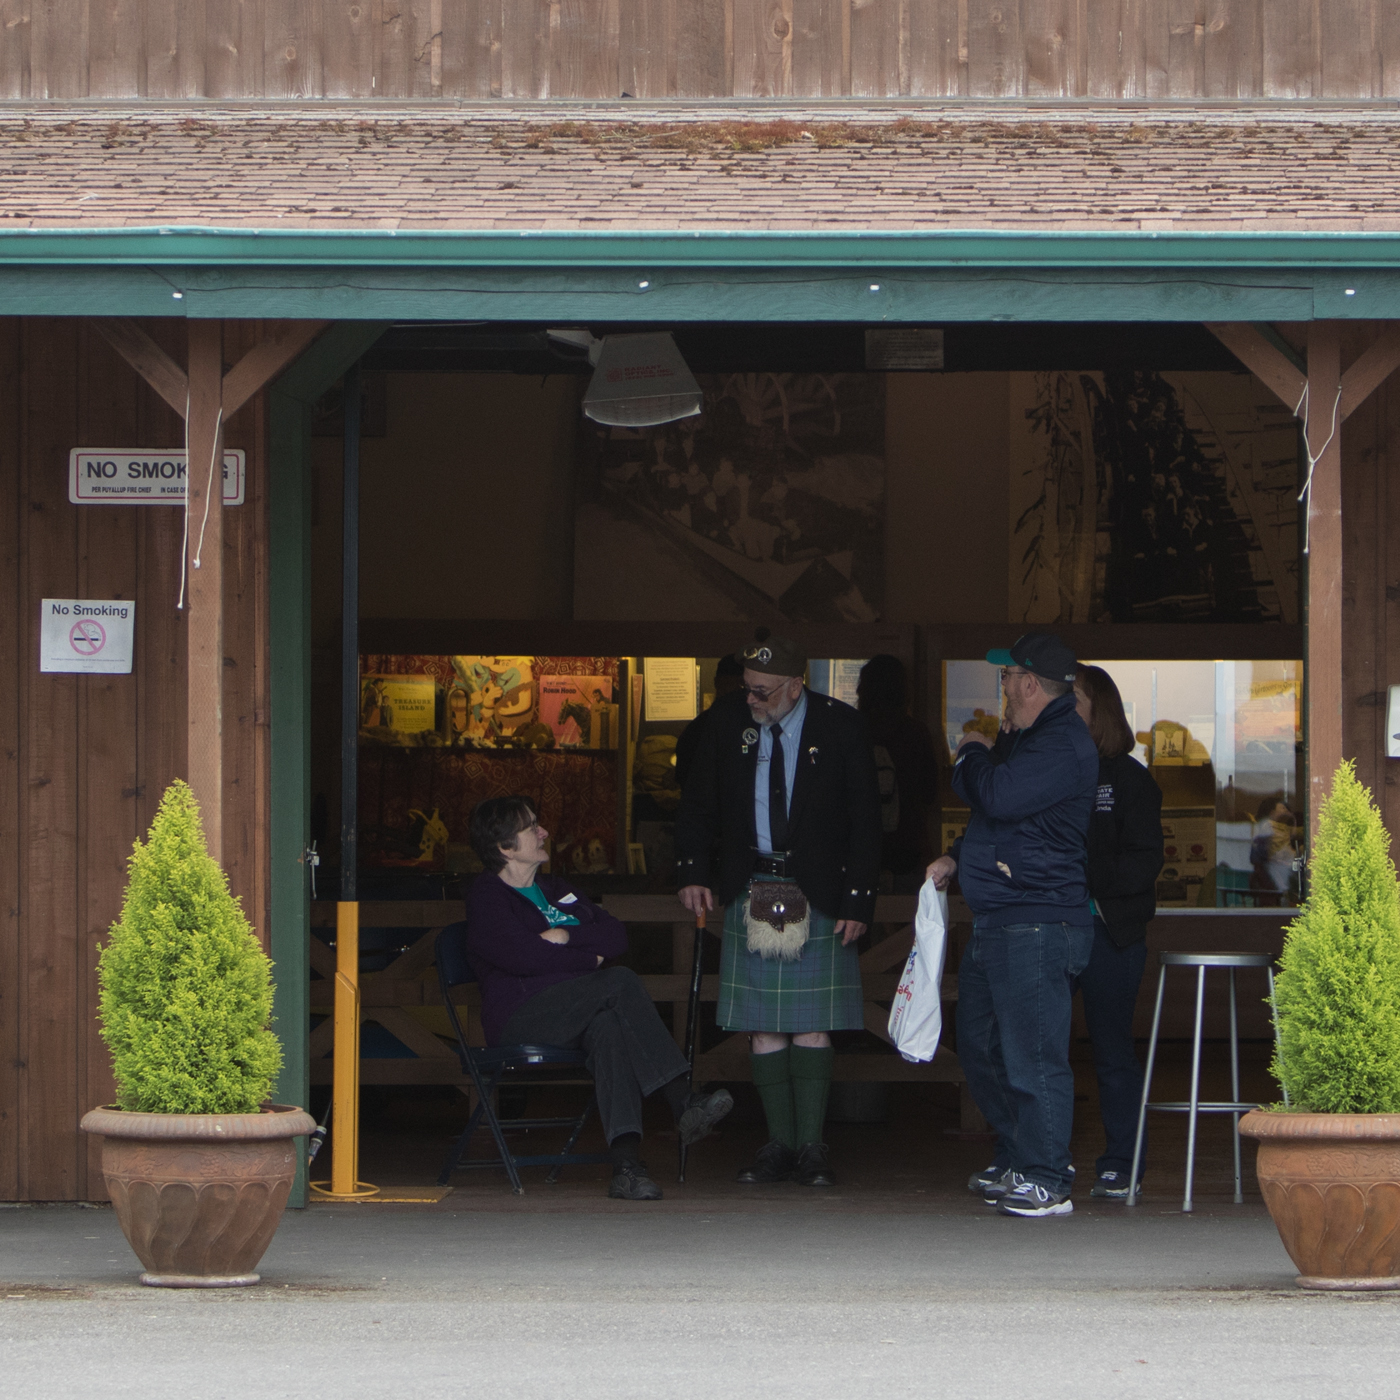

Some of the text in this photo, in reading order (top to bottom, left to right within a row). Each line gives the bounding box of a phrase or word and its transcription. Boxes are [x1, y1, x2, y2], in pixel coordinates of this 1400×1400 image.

[86, 461, 118, 478] NO
[52, 604, 128, 619] No Smoking
